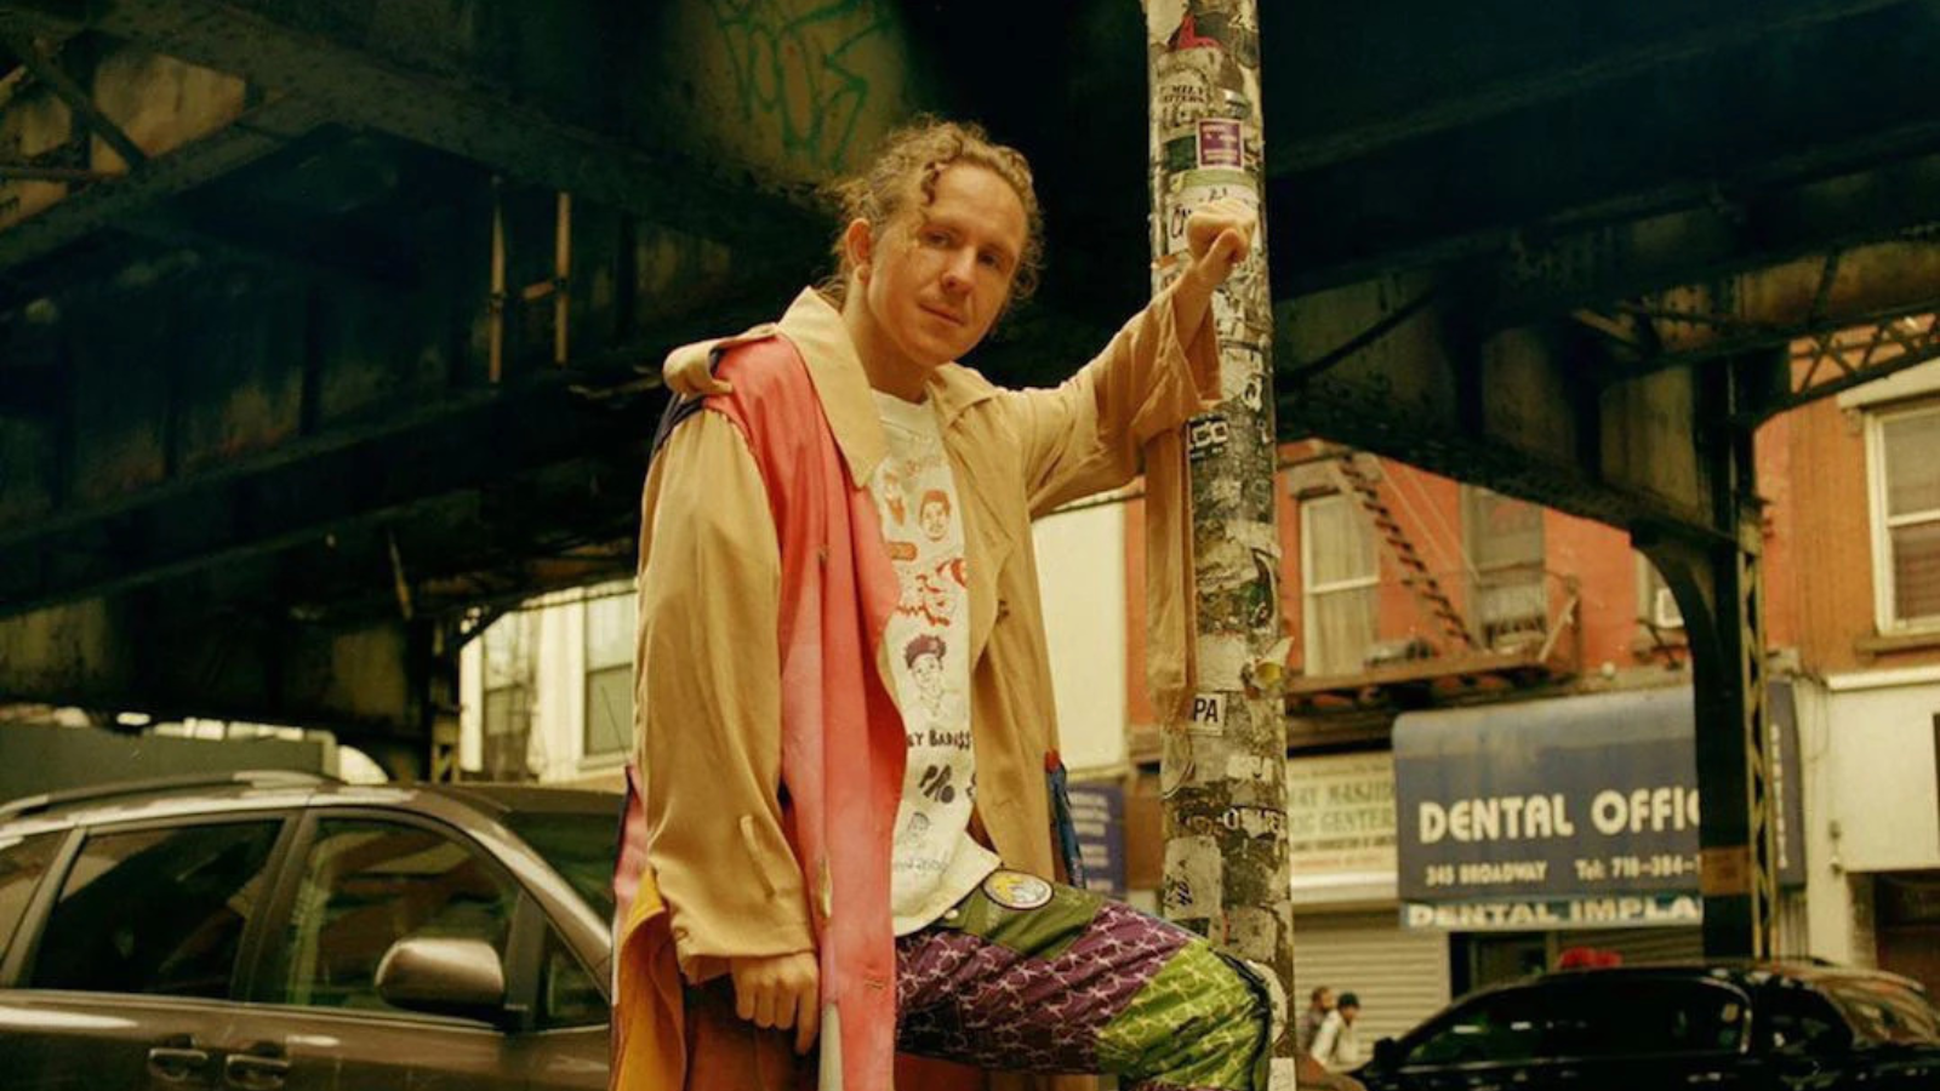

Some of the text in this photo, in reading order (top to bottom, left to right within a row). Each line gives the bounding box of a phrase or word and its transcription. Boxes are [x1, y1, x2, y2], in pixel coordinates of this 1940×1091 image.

[1193, 697, 1219, 724] PA
[1418, 793, 1575, 843] DENTAL
[1459, 861, 1548, 885] BROADWAY
[1408, 901, 1559, 928] DENTAL
